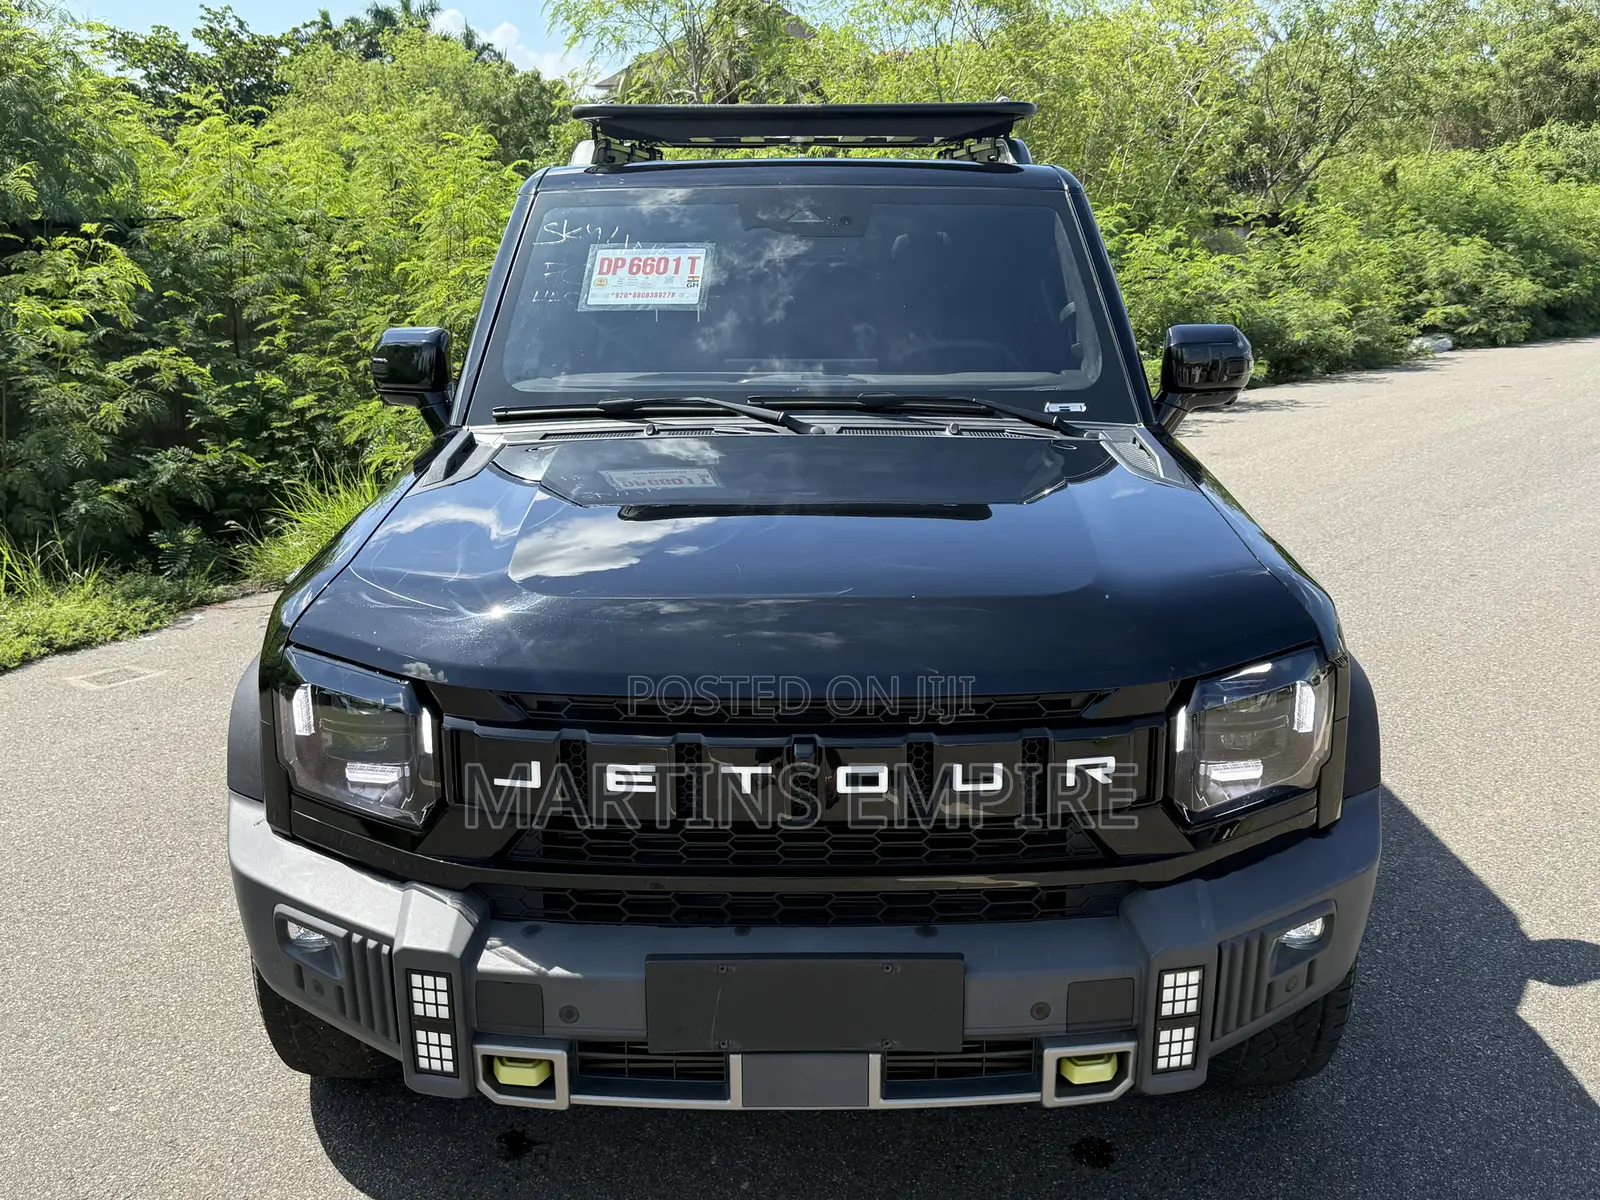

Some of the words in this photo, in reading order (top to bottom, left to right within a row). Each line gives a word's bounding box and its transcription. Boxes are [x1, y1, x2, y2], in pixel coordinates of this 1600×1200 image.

[598, 257, 626, 276] DP
[628, 256, 682, 276] 6601
[687, 256, 701, 275] T
[493, 756, 1116, 794] JETOUR
